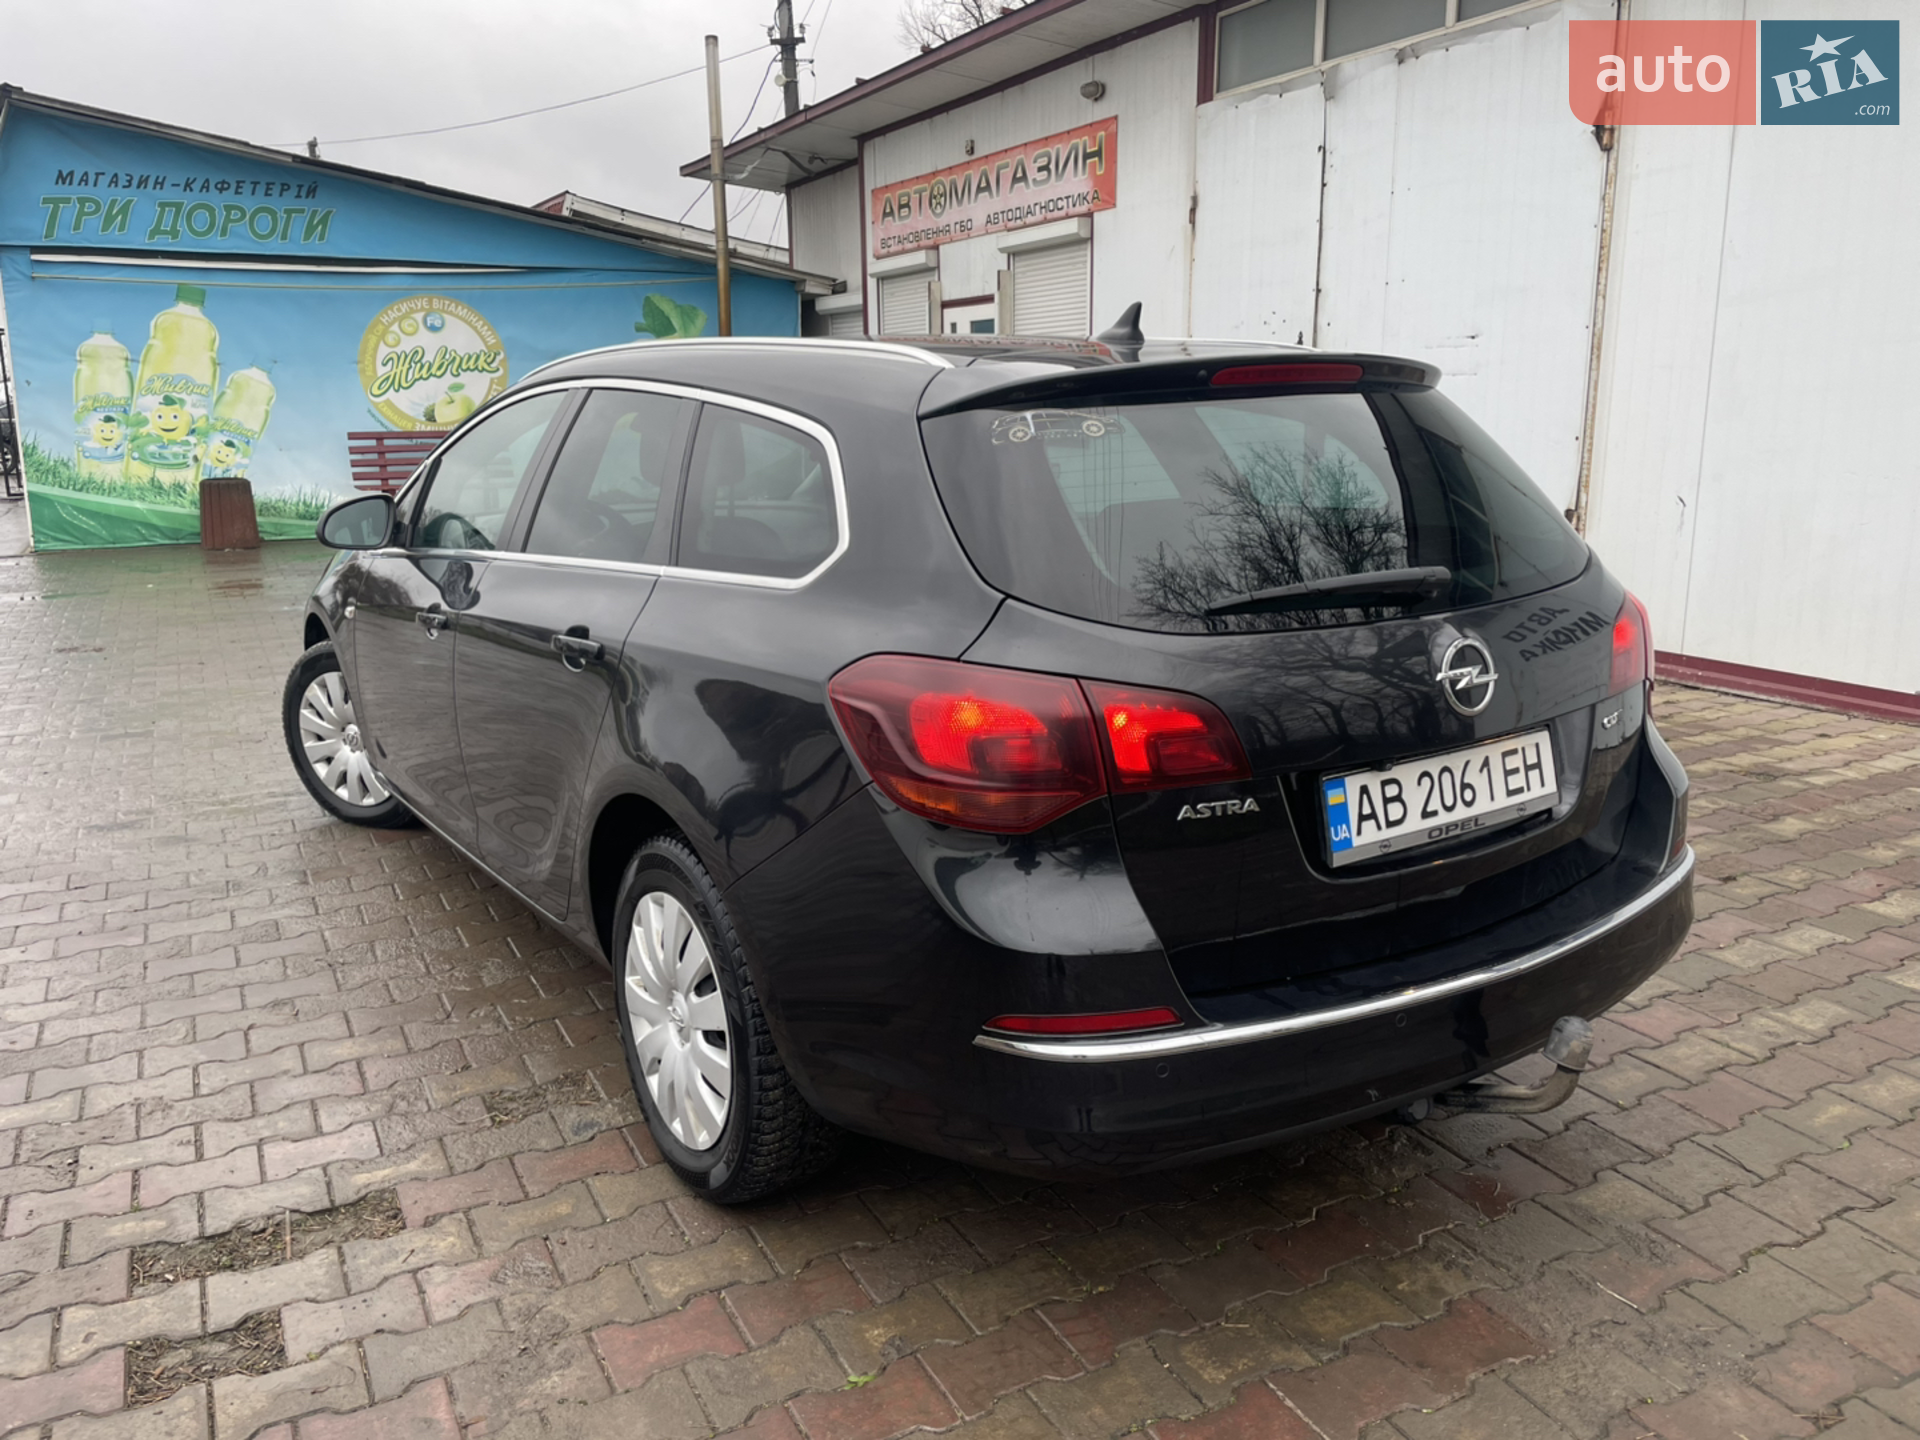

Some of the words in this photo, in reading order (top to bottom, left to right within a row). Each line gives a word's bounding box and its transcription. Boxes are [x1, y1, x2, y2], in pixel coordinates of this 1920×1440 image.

[880, 131, 1105, 226] АВТОМАГАЗИН
[40, 195, 137, 241] ТРИ
[145, 200, 336, 244] ДОРОГИ
[880, 224, 951, 249] ВСТАНОВЛЕННЯ
[953, 219, 973, 234] ГБО
[985, 188, 1101, 227] АВТОДІАГНОСТИКА
[379, 297, 430, 326] НАСИЧУЄ
[432, 298, 497, 346] ВІТАМІНАМИ
[426, 316, 443, 328] Fe
[370, 345, 501, 398] Живчик
[1177, 797, 1260, 821] ASTRA
[1355, 776, 1408, 837] AB
[1416, 755, 1495, 820] 2061
[1501, 742, 1546, 798] EH
[1331, 824, 1351, 842] UA
[1427, 817, 1486, 840] OPEL
